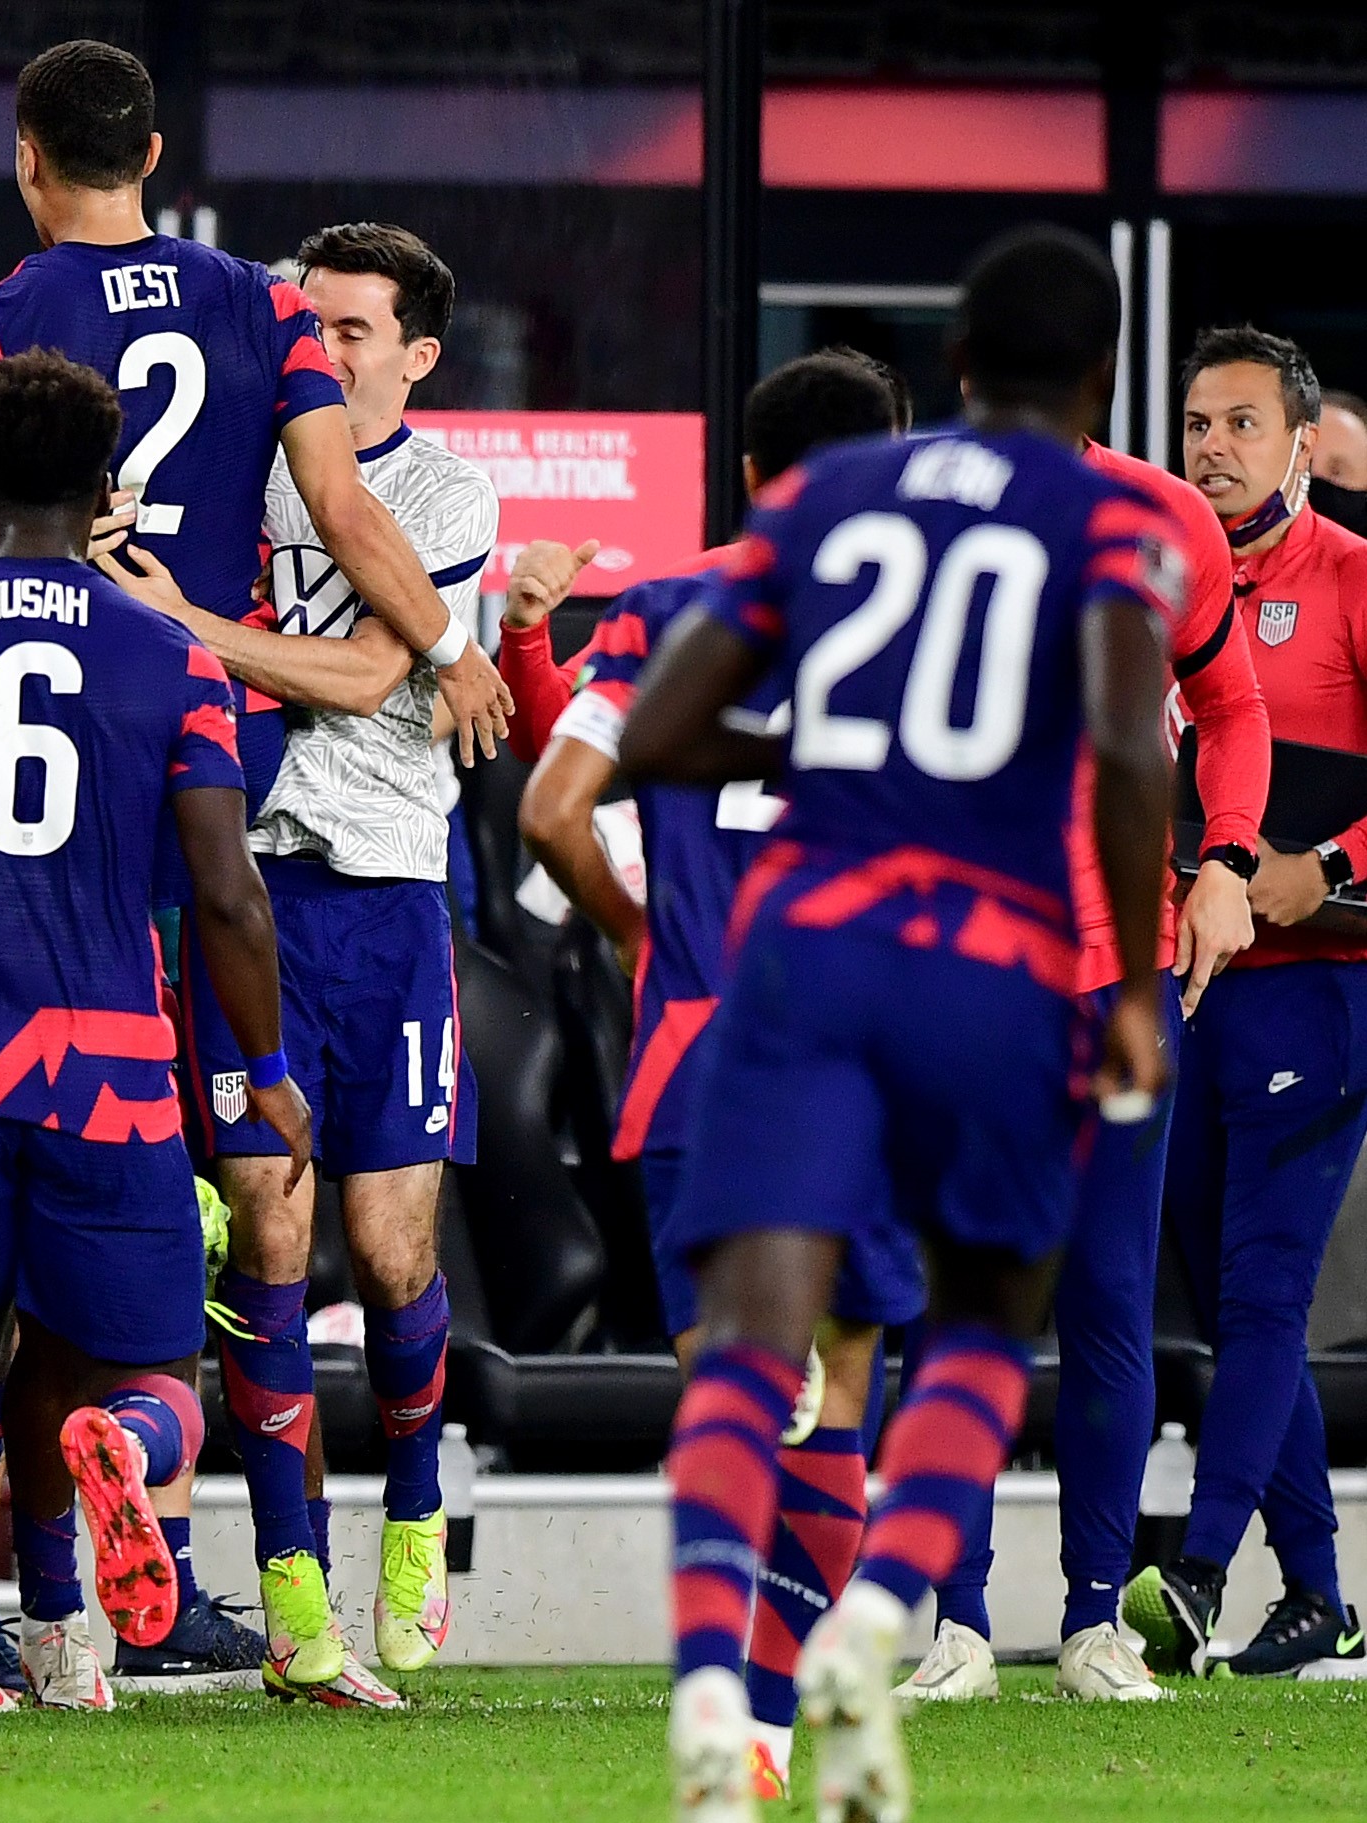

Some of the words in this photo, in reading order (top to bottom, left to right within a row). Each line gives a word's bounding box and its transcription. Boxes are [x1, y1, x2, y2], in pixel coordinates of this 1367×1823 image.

[101, 263, 181, 314] DEST
[118, 331, 206, 535] 2
[534, 430, 637, 457] HEALTHY.
[1262, 603, 1294, 622] USA
[789, 510, 1051, 782] 20
[214, 1074, 245, 1094] USA
